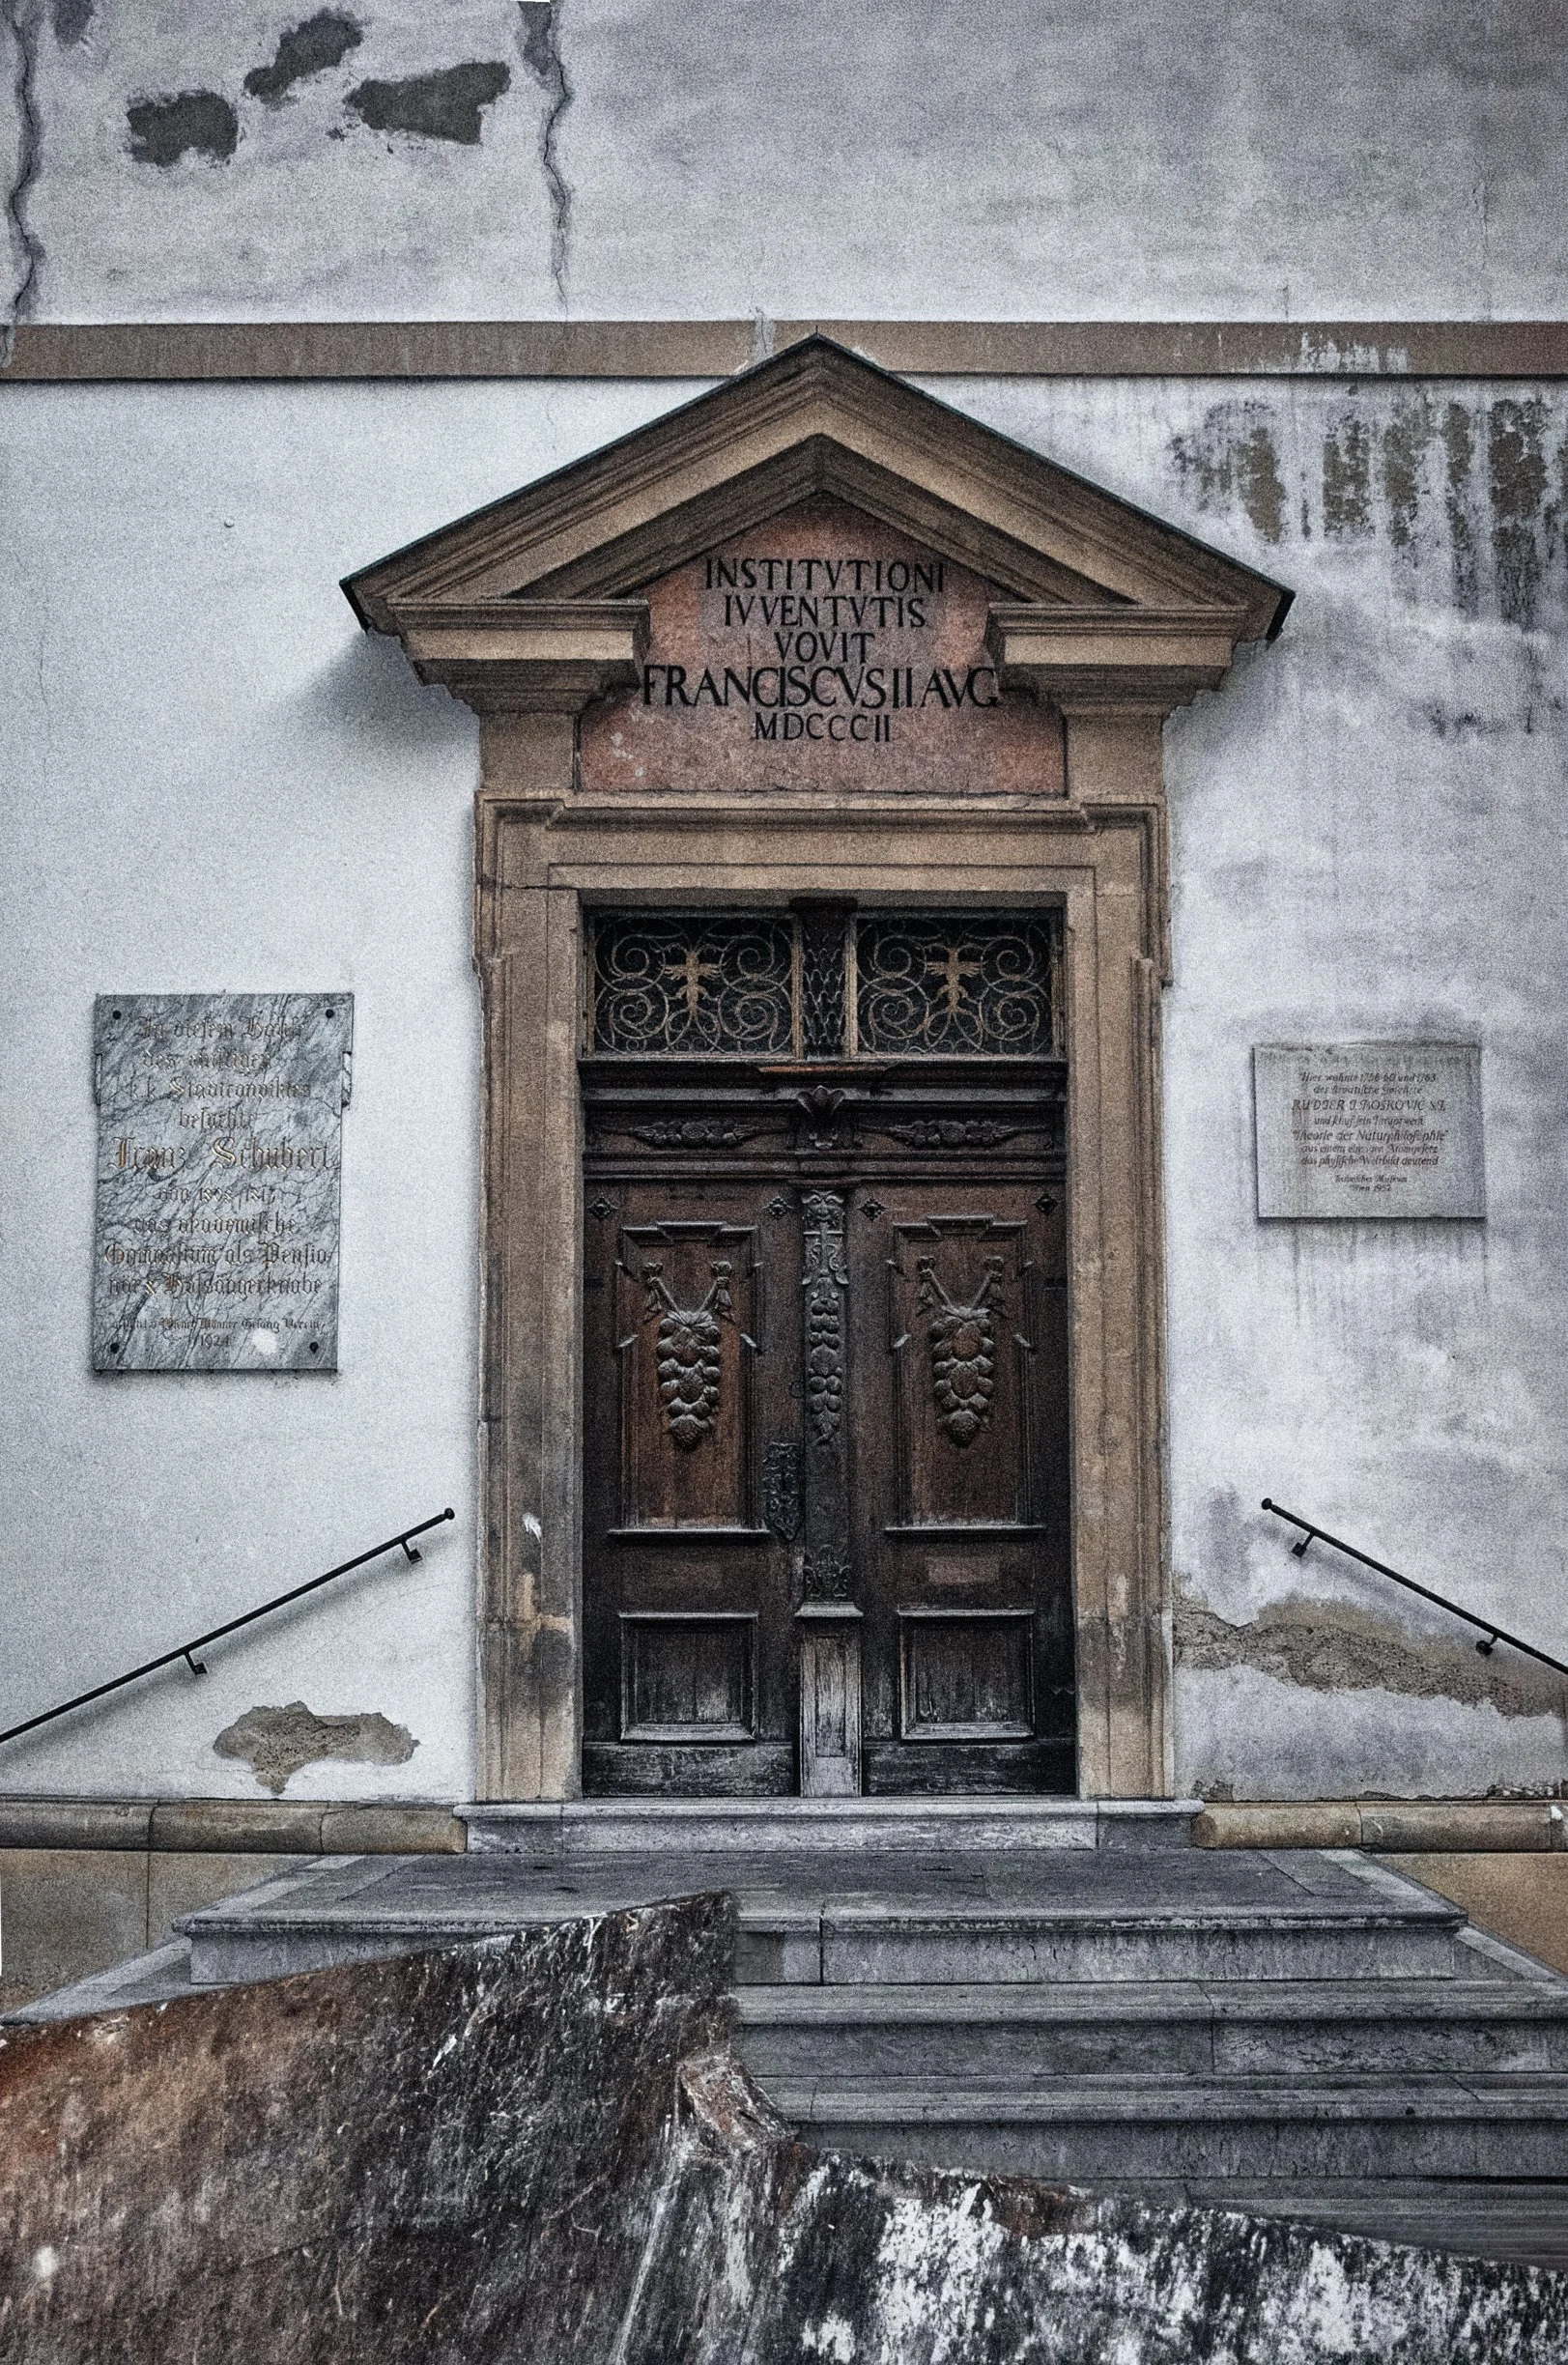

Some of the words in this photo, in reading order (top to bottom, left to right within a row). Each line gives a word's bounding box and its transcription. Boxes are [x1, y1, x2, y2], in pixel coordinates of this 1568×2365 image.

[704, 557, 946, 593] INSTITVTIONI
[724, 595, 927, 628] IVVENTVTIS
[774, 631, 876, 664] VOVIT
[642, 664, 888, 709] FRANCISCVS
[754, 712, 892, 743] MDCCCII
[210, 1136, 329, 1172] Schubert
[200, 1333, 230, 1351] 1924
